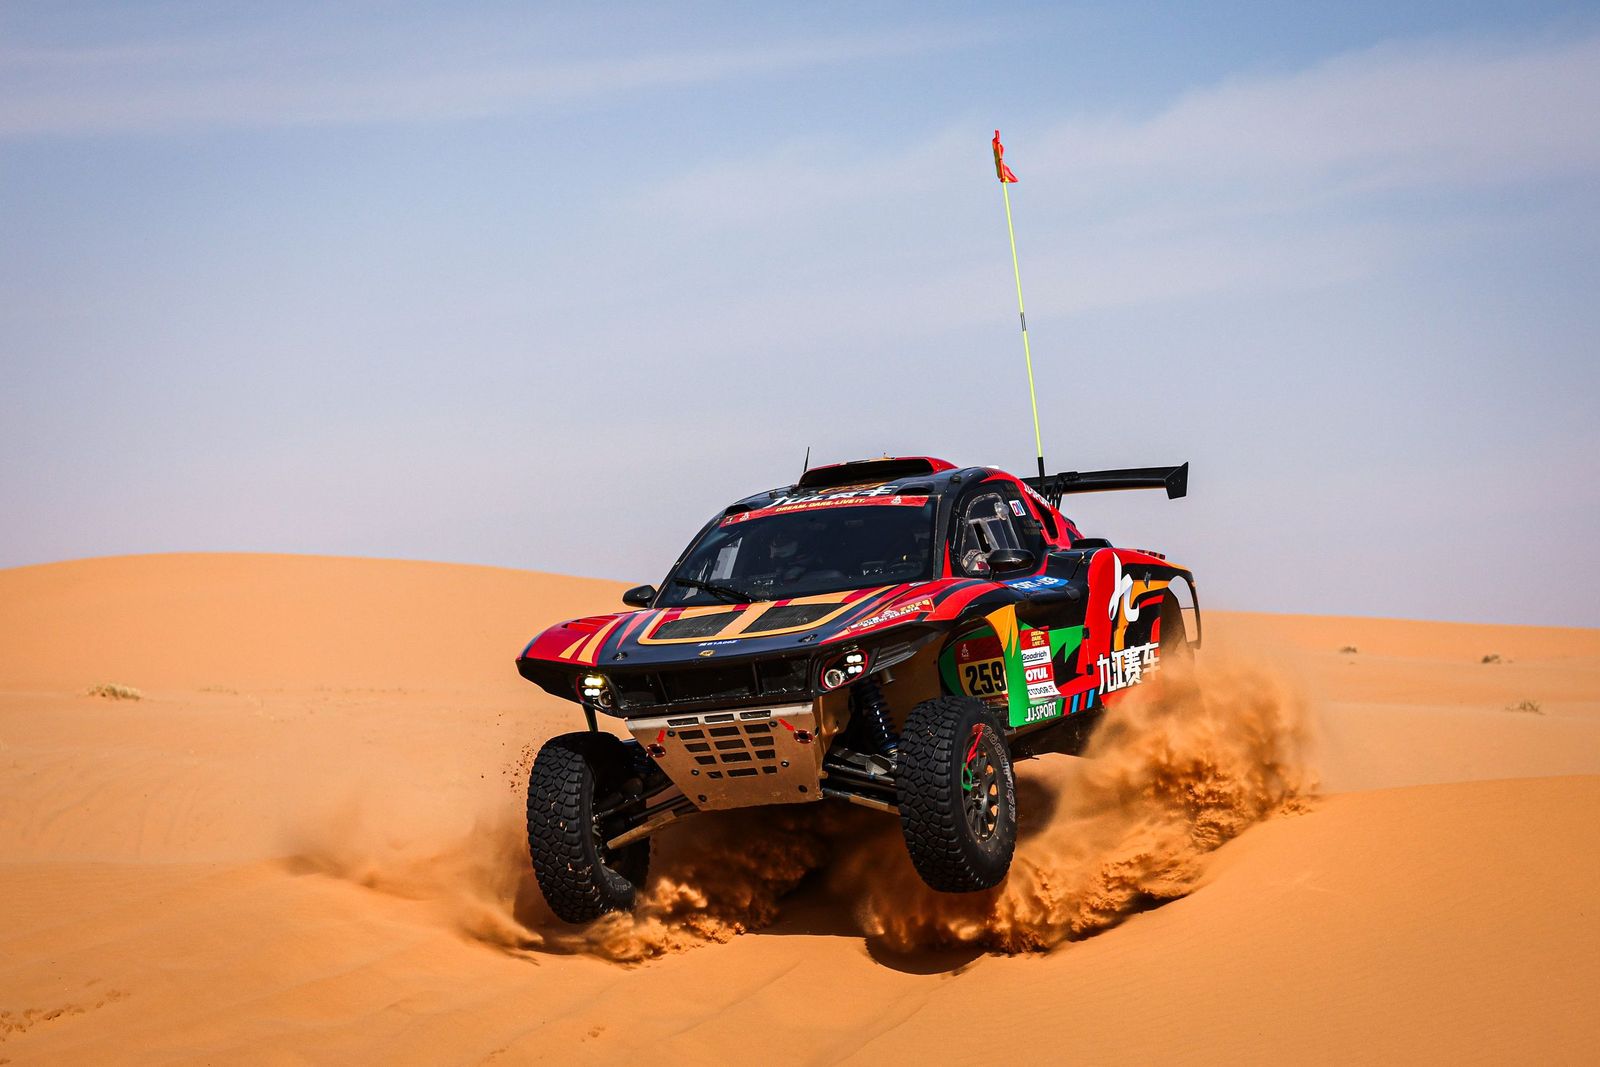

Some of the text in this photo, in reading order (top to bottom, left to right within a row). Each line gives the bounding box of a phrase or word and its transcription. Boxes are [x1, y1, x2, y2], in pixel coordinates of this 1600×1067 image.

[965, 661, 1006, 696] 259
[1025, 667, 1048, 681] OTUL
[1097, 642, 1160, 695] 九江赛车
[1025, 701, 1057, 721] JJ-SPORT
